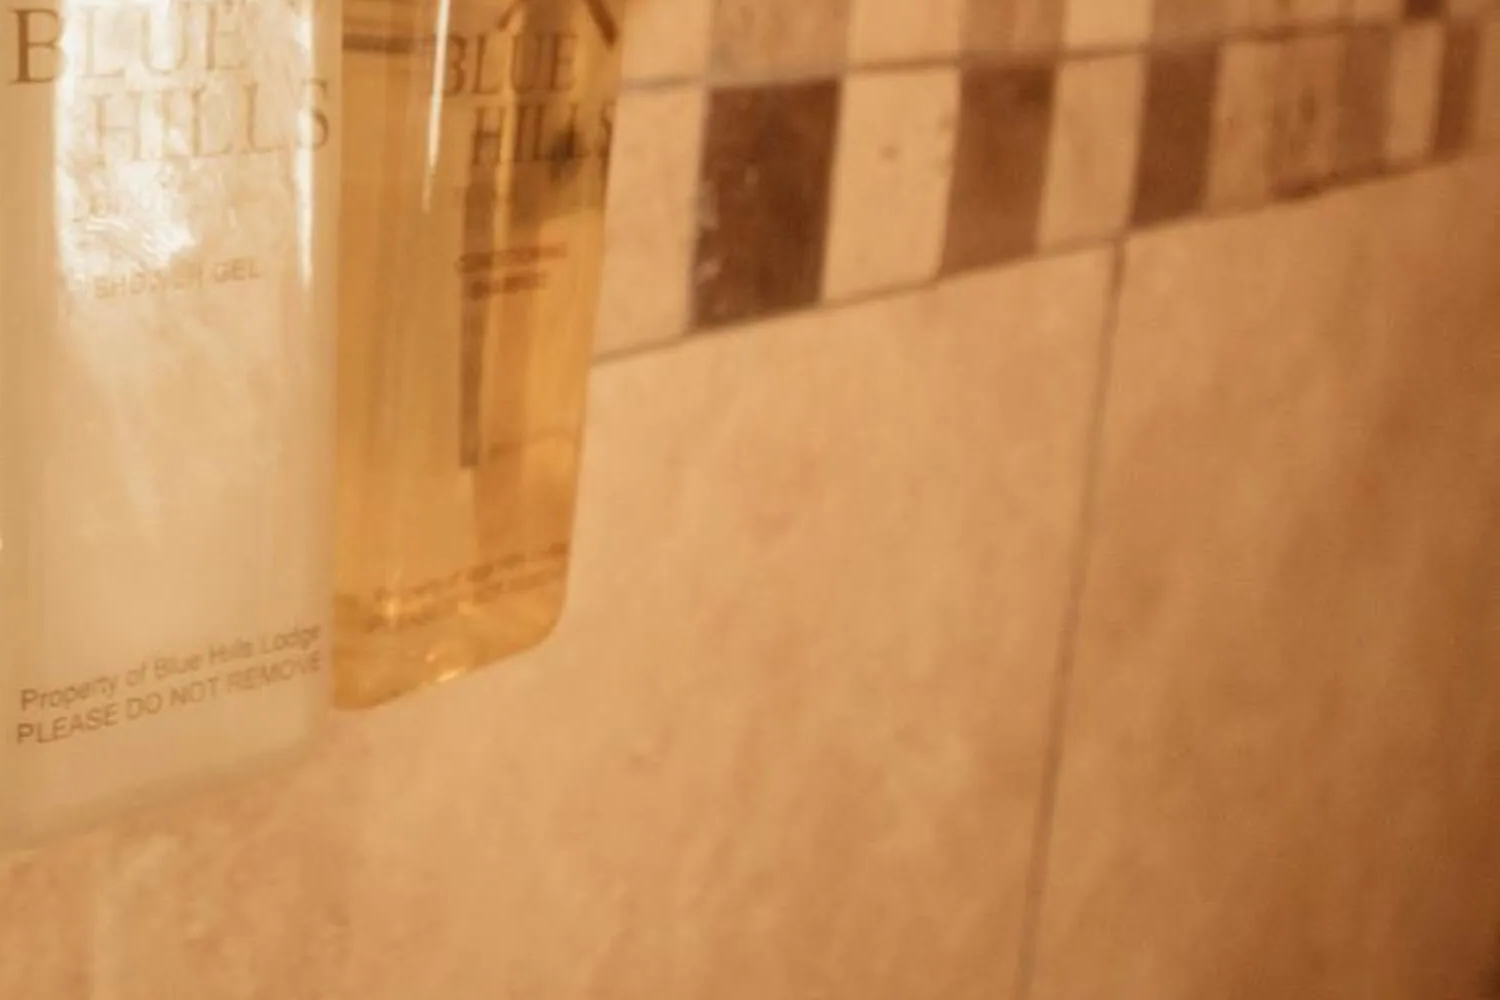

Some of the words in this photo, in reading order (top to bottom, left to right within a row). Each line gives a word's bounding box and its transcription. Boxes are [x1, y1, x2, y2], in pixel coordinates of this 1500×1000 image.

[16, 702, 120, 746] PLEASE
[126, 691, 163, 722] DO
[170, 675, 220, 708] NOT
[227, 650, 323, 694] REMOVE
[20, 674, 118, 712] Property
[126, 660, 150, 688] of
[154, 652, 203, 680] Blue
